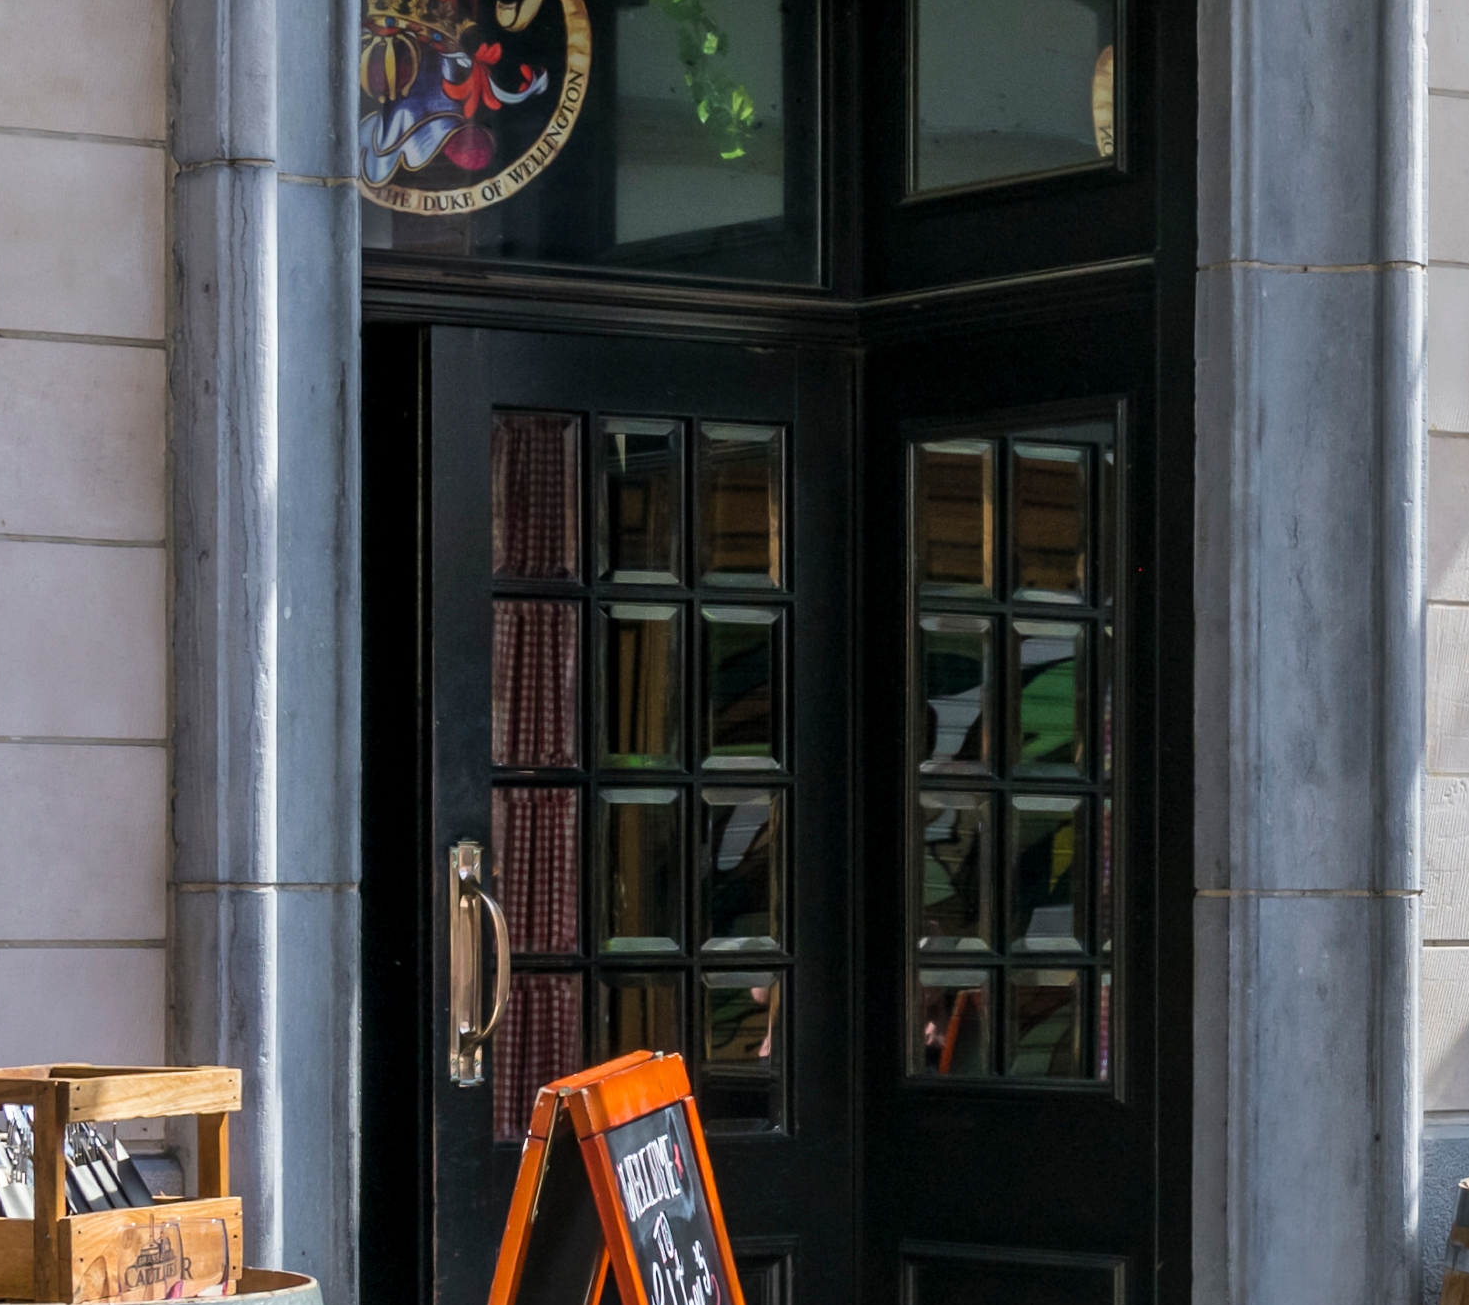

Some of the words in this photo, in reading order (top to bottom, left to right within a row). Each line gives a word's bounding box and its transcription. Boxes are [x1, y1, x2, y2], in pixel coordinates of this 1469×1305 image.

[423, 191, 475, 212] DUKE
[481, 179, 504, 203] OF
[507, 68, 584, 185] WELLINGTON
[617, 1133, 681, 1222] WELCOME
